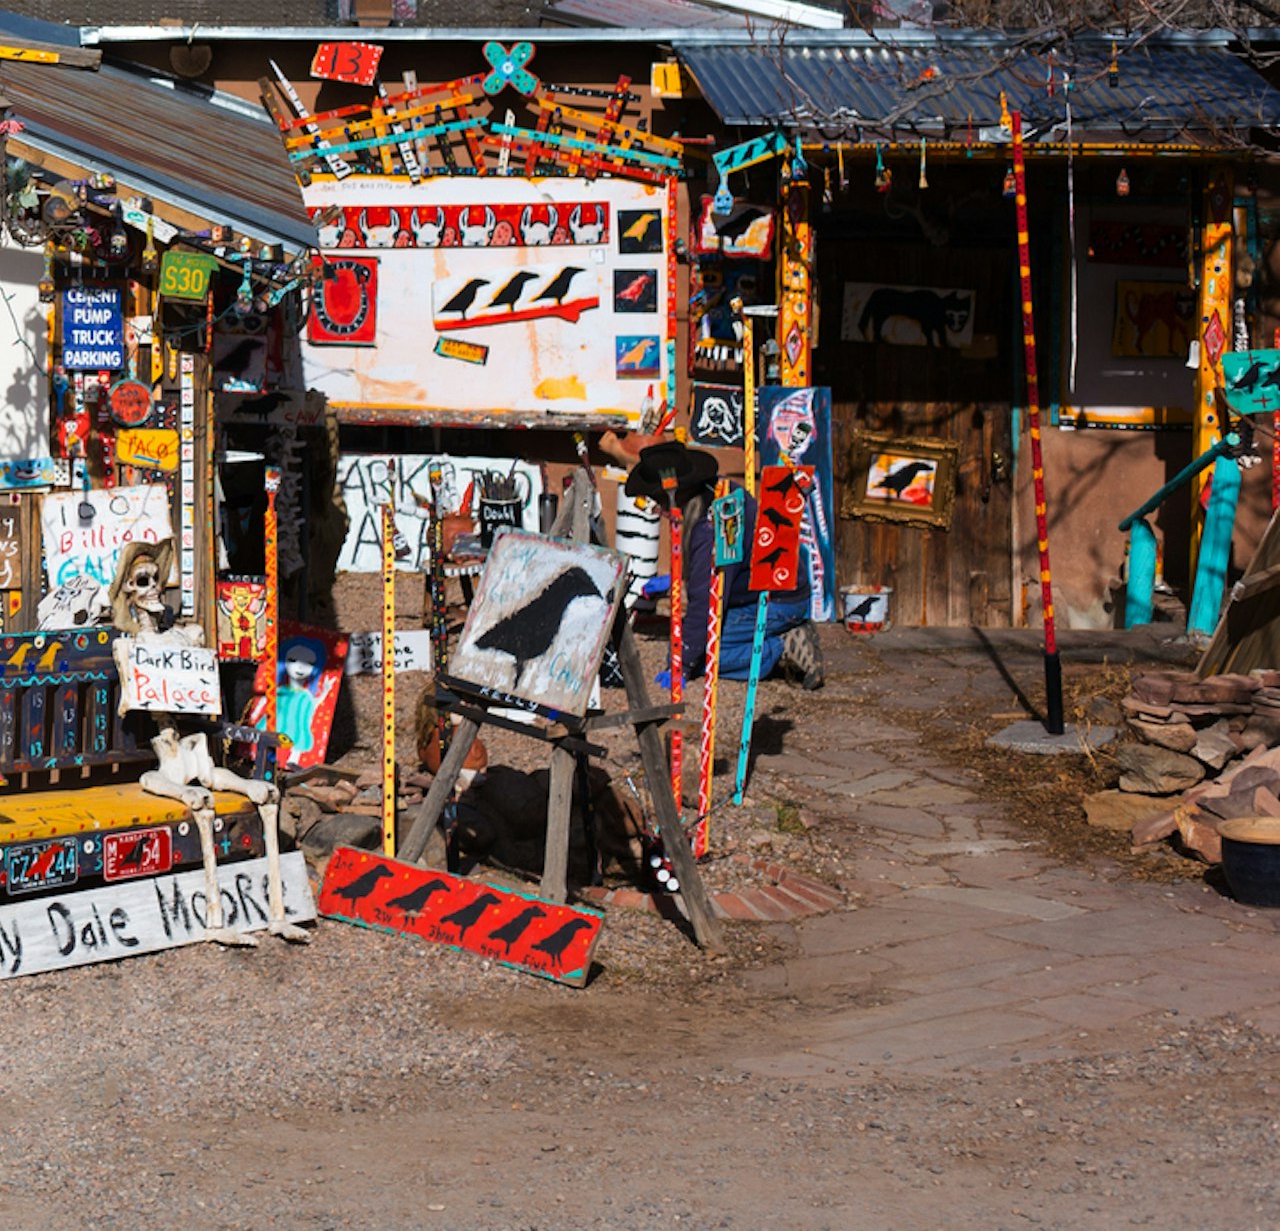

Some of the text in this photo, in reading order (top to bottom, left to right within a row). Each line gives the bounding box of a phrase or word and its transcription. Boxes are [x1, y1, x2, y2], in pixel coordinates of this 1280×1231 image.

[329, 46, 363, 76] 13
[165, 265, 205, 294] S30
[68, 288, 118, 304] CEMENT
[73, 309, 113, 325] PUMP
[72, 330, 115, 346] TRUCK
[65, 351, 122, 367] PARKING
[284, 408, 322, 424] CAW
[60, 525, 159, 554] Billion
[135, 646, 217, 672] Dark Bird
[361, 658, 414, 670] coor
[134, 669, 216, 705] Palace
[46, 900, 140, 958] Dale
